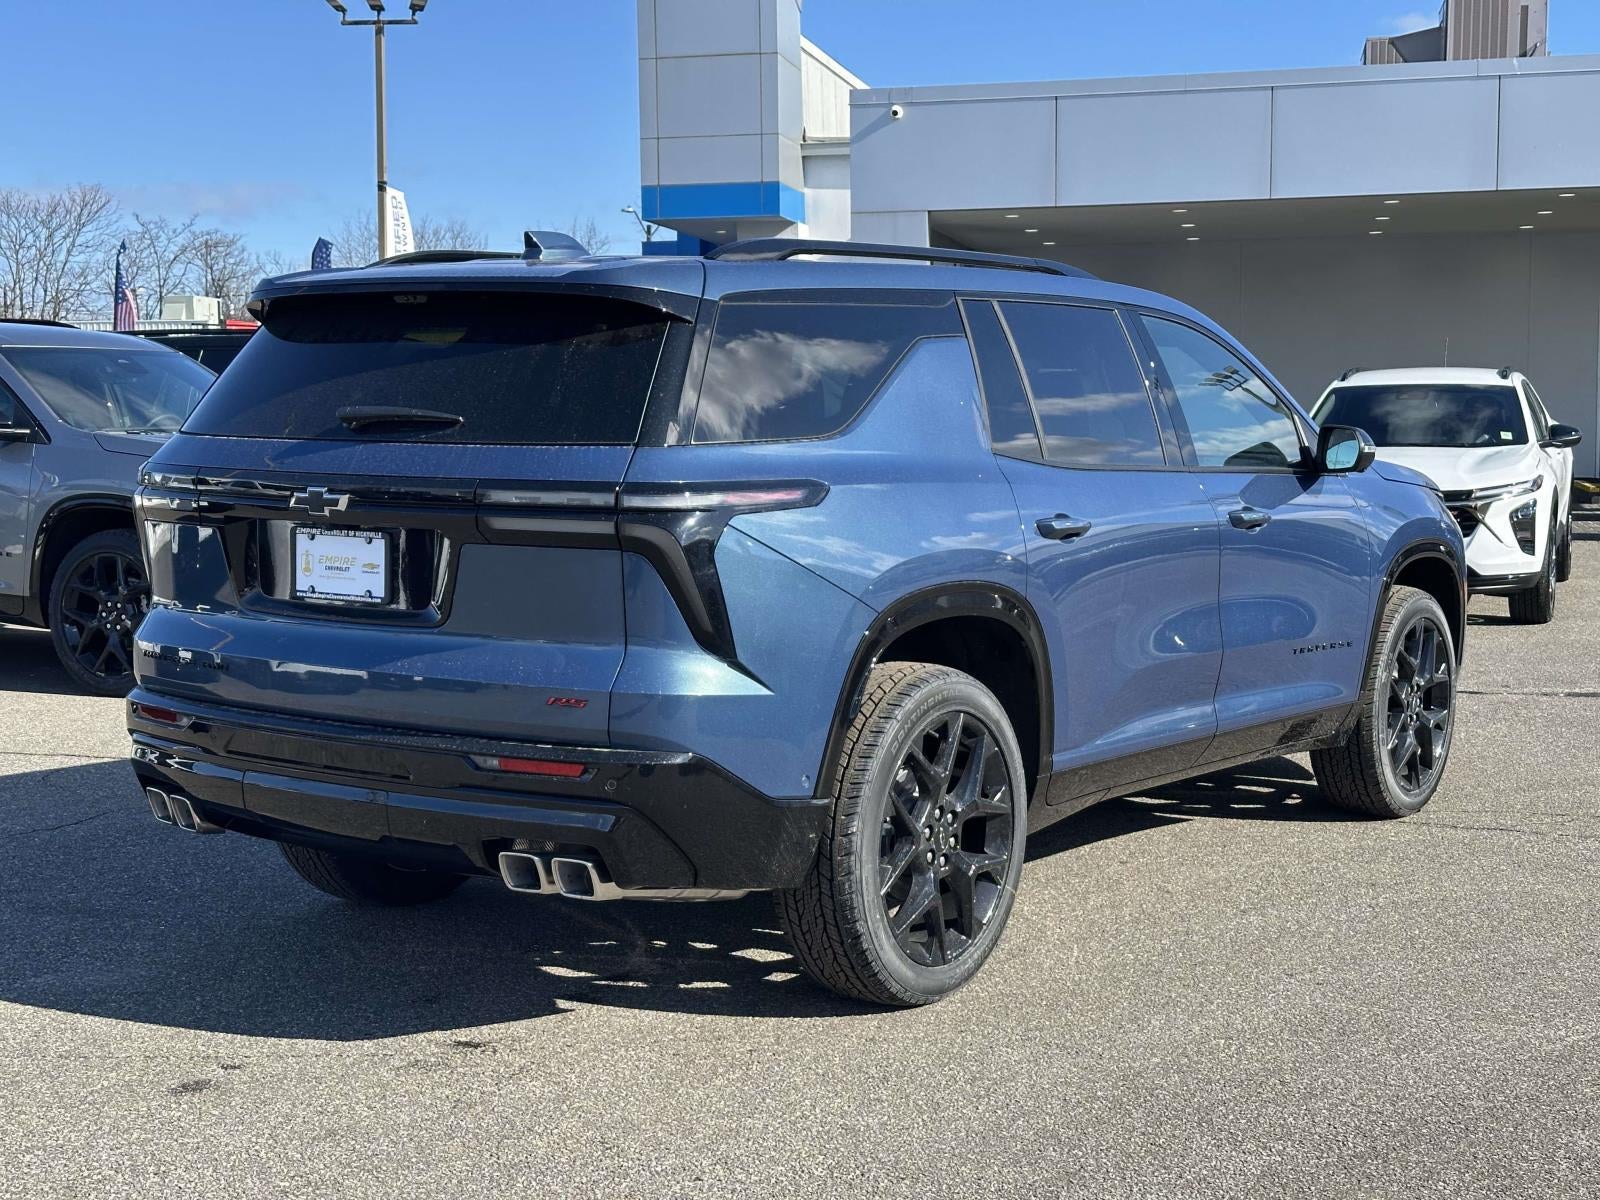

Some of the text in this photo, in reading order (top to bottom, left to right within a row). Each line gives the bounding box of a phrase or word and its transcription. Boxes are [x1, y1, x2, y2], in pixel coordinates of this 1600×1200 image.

[296, 527, 321, 535] EMPIRE
[318, 554, 357, 567] EMPIRE
[324, 565, 350, 573] CHEVROLET
[1292, 641, 1353, 656] TRAVERSE
[545, 696, 588, 708] RS
